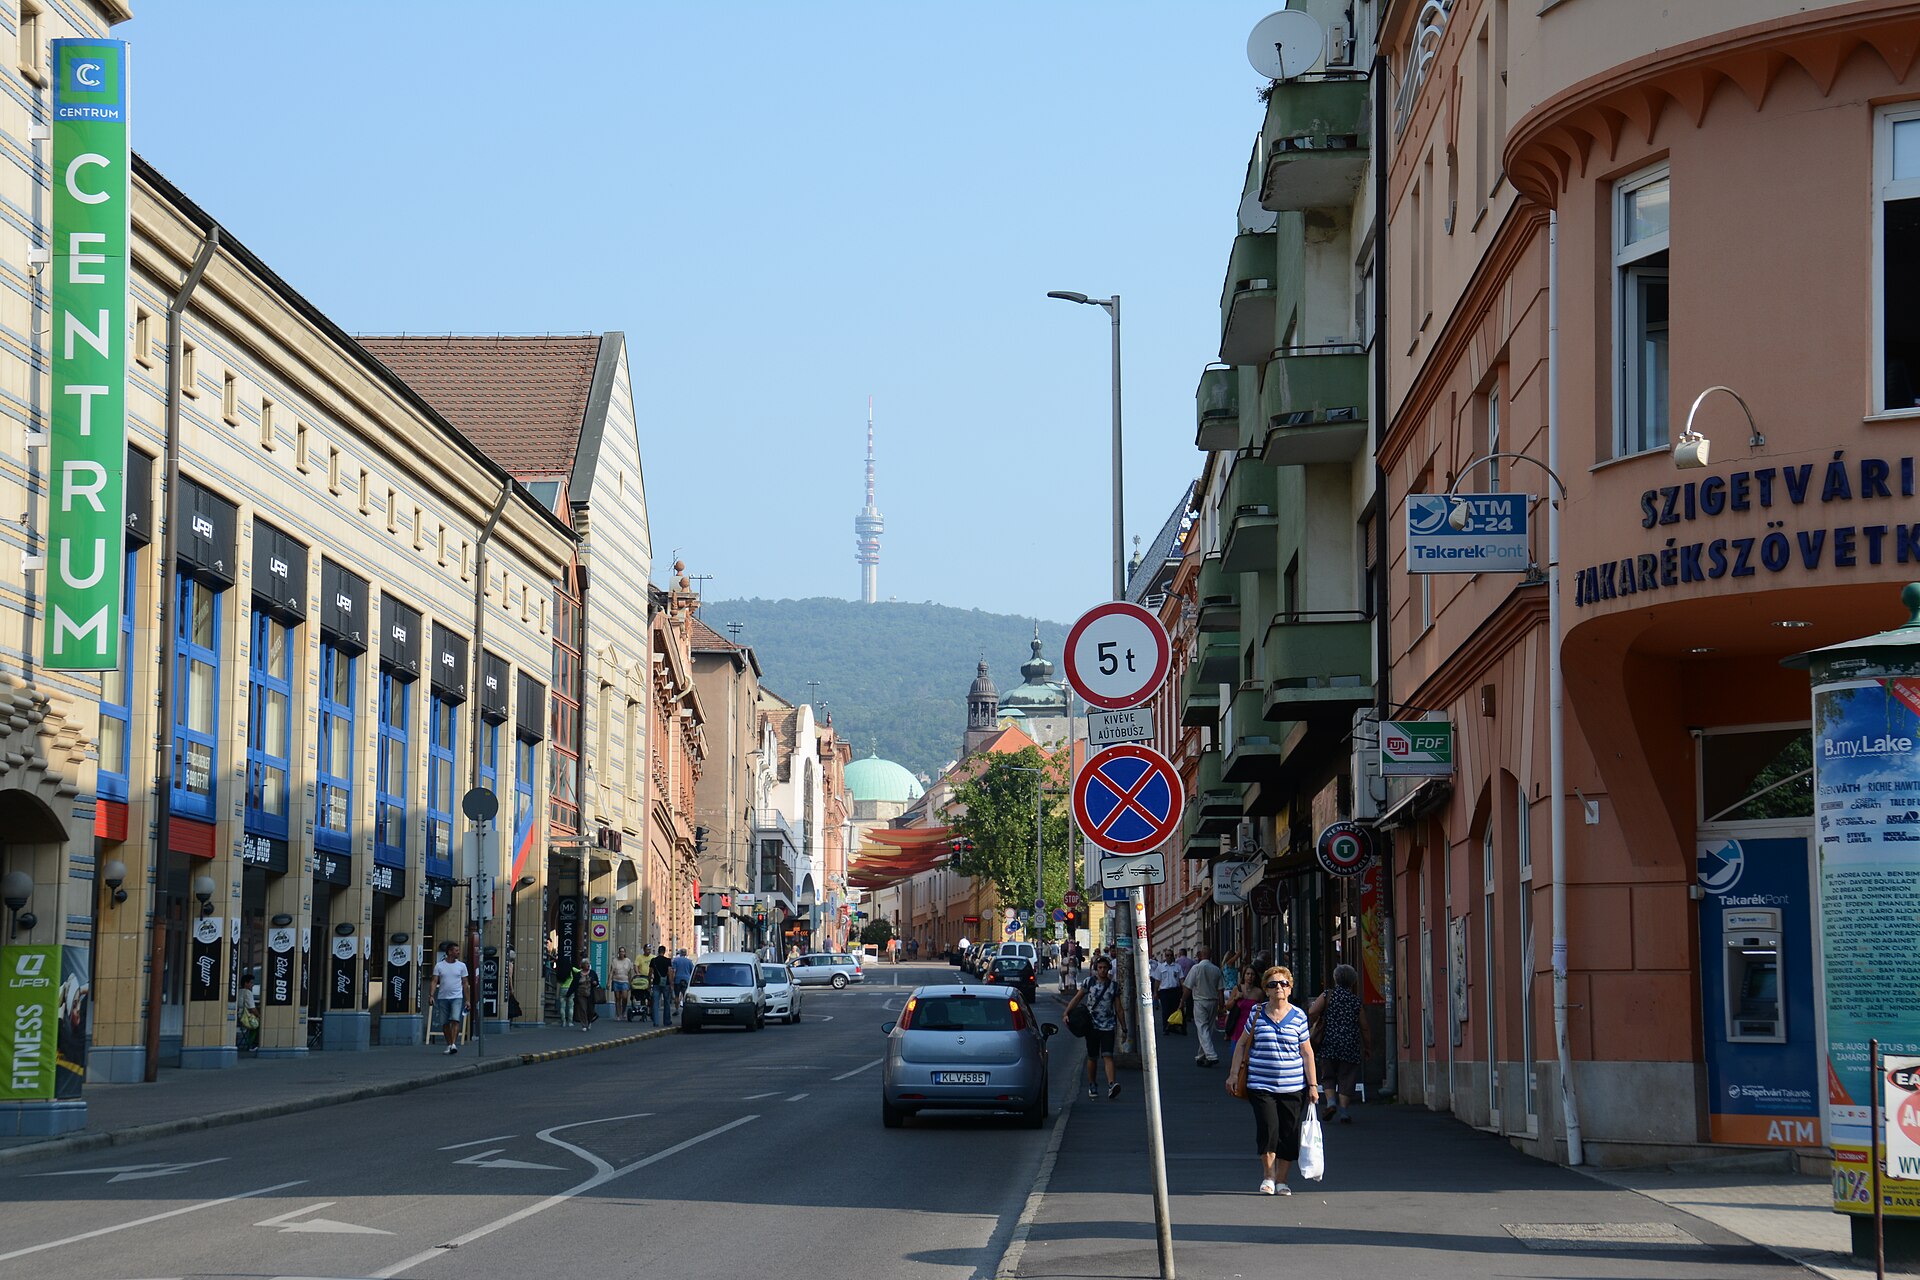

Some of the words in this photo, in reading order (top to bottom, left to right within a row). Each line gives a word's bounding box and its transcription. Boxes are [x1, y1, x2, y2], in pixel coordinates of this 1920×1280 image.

[59, 107, 119, 119] CENTRUM
[52, 152, 111, 655] CENTRUM
[1640, 450, 1915, 530] SZIGETVÁRI
[1467, 500, 1512, 516] ATM
[1574, 519, 1920, 608] TAKARÉKSZÖVETK
[1097, 641, 1119, 676] 5
[1125, 648, 1137, 673] t
[1103, 712, 1136, 725] KIVÉVE
[1415, 737, 1445, 749] FDF
[1824, 735, 1913, 758] B.my.Lake
[1340, 844, 1351, 854] T
[1064, 895, 1080, 904] STOP
[1718, 894, 1790, 906] TakarékPont
[196, 955, 216, 987] liquor
[274, 956, 289, 978] Billy
[275, 979, 288, 1002] BOB
[11, 1003, 44, 1089] FITNESS
[1845, 1041, 1904, 1052] AUGUZTUS
[1766, 1119, 1815, 1143] ATM
[1895, 1197, 1915, 1207] AXA
